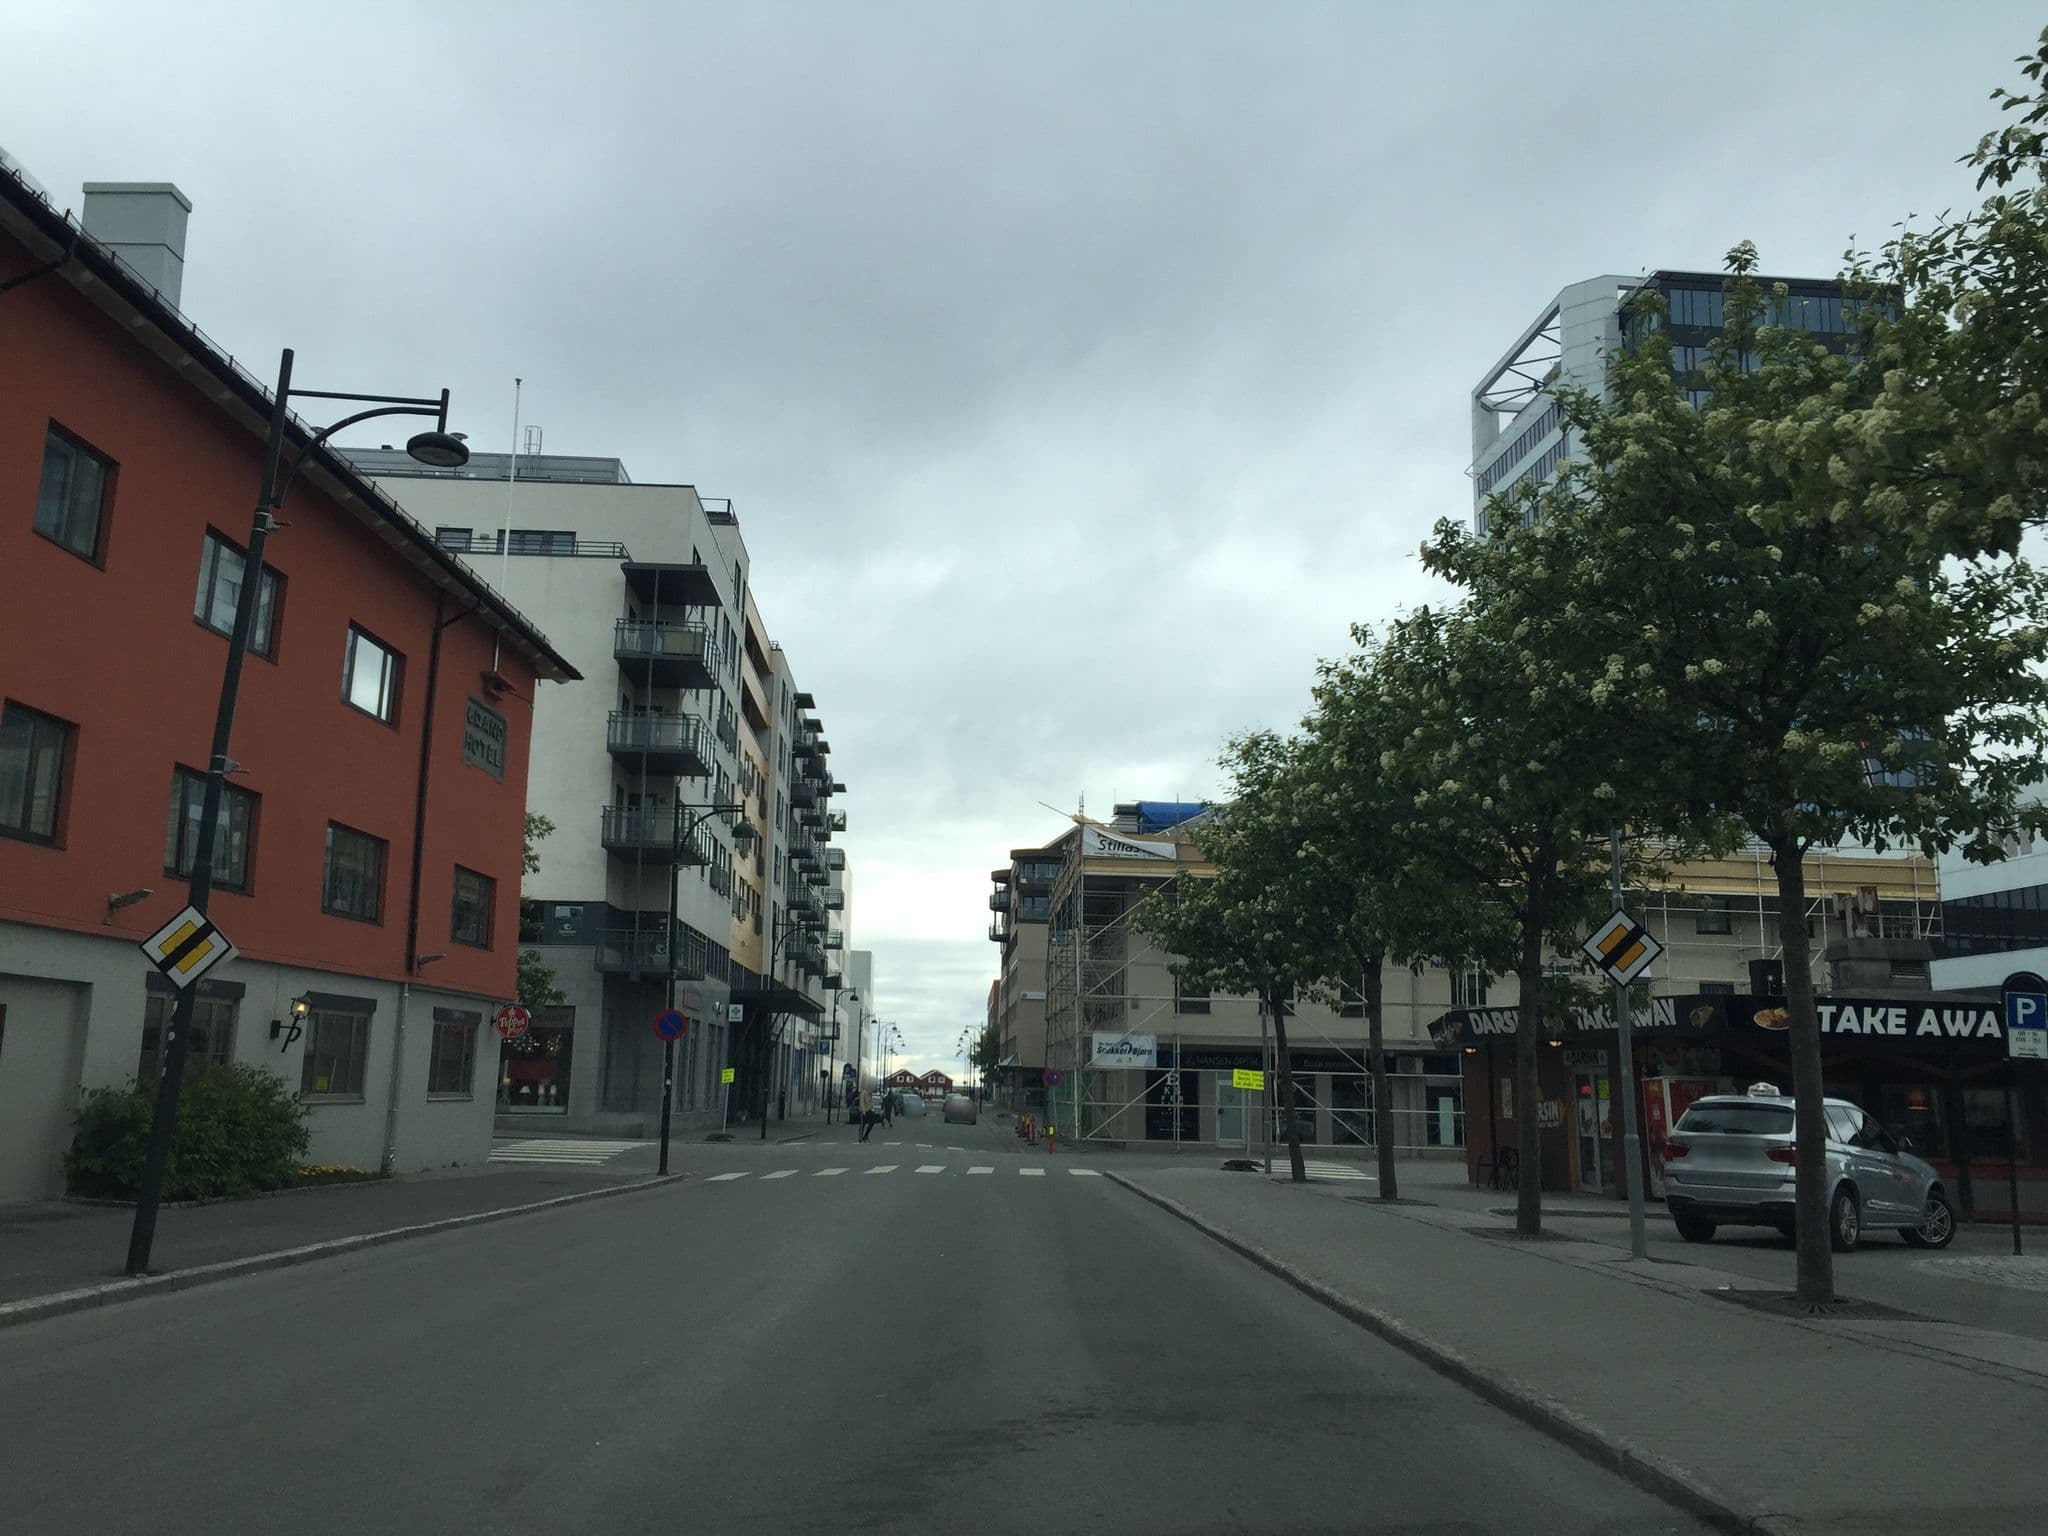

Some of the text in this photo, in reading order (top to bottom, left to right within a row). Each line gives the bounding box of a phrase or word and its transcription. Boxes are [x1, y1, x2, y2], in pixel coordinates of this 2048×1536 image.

[1817, 1004, 2003, 1039] TAKE AWA
[2016, 997, 2037, 1025] P
